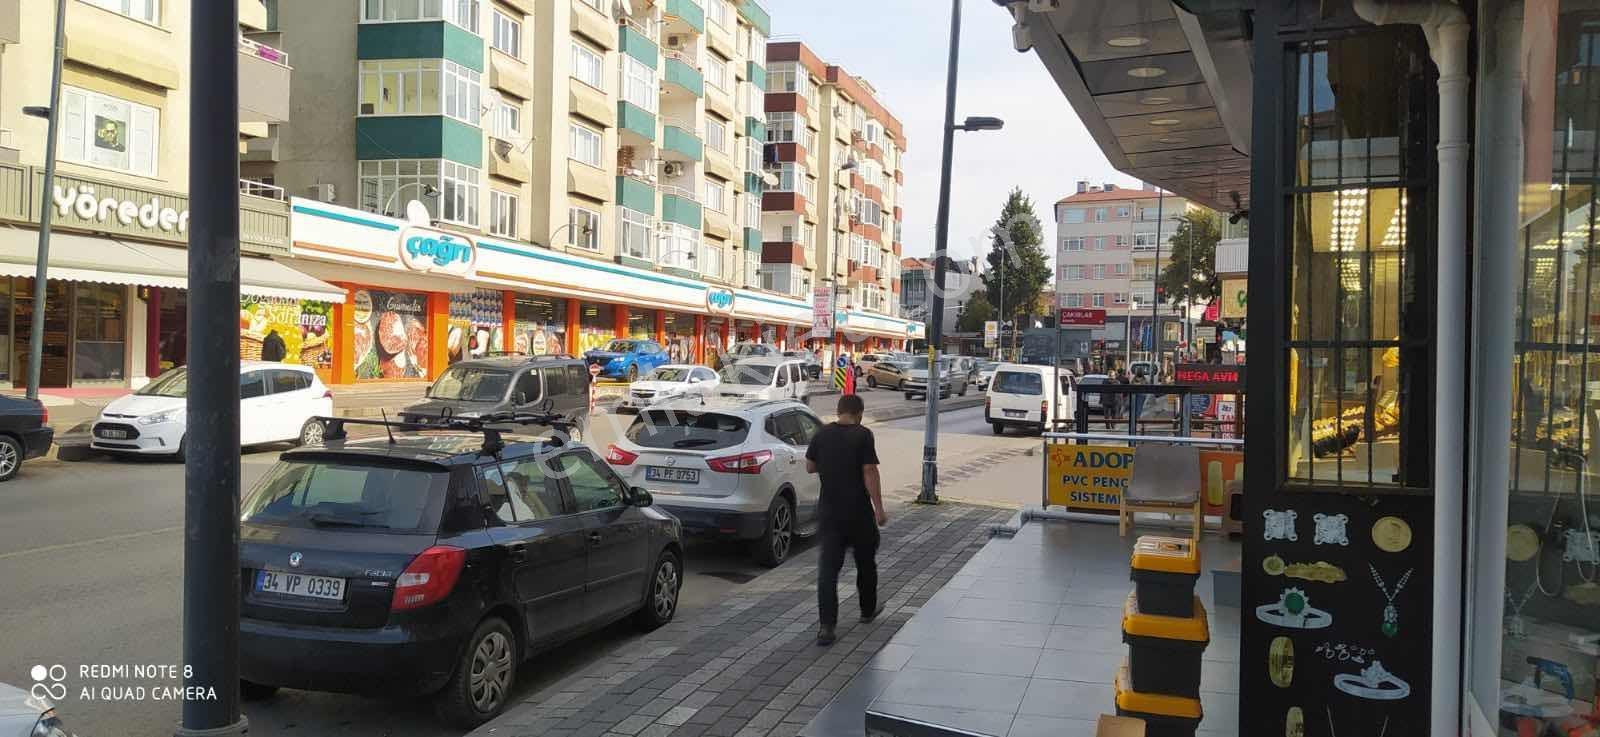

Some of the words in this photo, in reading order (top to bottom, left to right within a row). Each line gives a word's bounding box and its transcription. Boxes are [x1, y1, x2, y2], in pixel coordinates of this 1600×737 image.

[406, 235, 471, 266] çağrı
[1063, 475, 1088, 486] PVC
[263, 573, 279, 590] 34
[286, 576, 300, 592] VP
[307, 580, 341, 597] 0339
